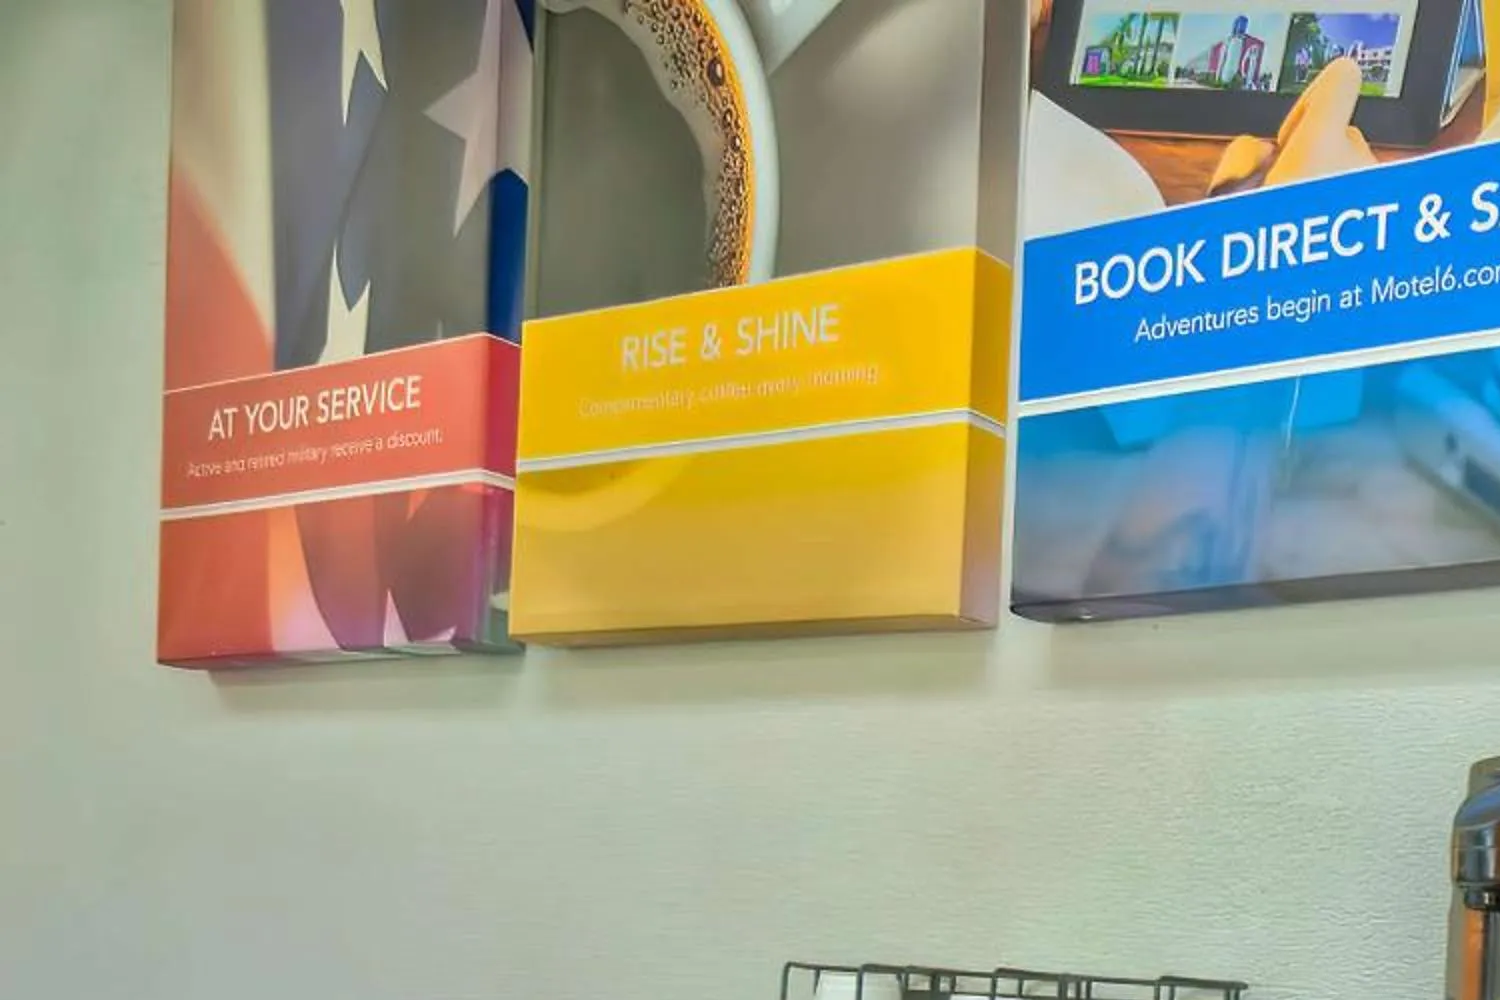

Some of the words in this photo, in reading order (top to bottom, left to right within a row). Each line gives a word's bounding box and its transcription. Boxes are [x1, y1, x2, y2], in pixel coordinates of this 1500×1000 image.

[1073, 238, 1207, 305] BOOK
[1221, 203, 1400, 275] DIRECT
[1414, 193, 1451, 243] &
[618, 325, 688, 374] RISE
[700, 322, 722, 362] &
[736, 302, 842, 357] SHINE
[1134, 303, 1259, 343] Adventures
[1266, 287, 1332, 325] begin
[1339, 284, 1364, 309] at
[208, 407, 238, 441] AT
[244, 395, 310, 436] YOUR
[316, 375, 422, 424] SERVICE
[374, 437, 383, 450] a
[386, 427, 443, 450] discount.
